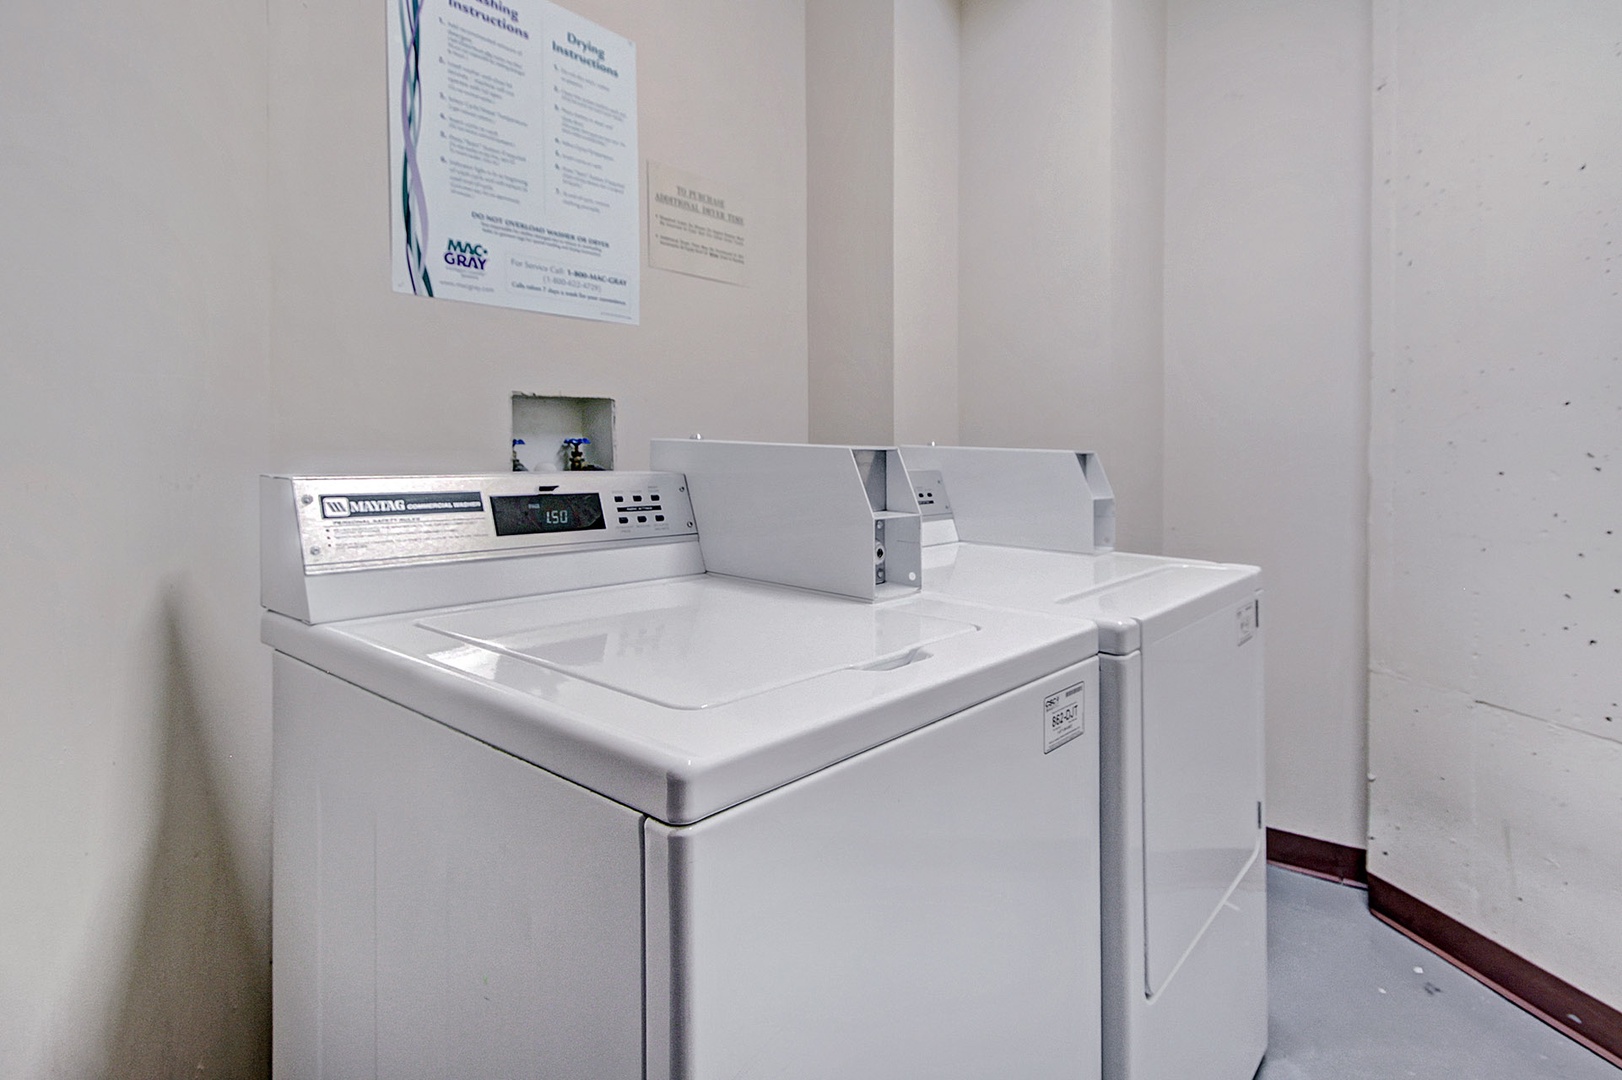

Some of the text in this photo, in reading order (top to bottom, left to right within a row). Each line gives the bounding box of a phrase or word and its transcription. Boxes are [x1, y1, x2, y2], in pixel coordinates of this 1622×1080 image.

[448, 0, 529, 40] Instructions
[552, 40, 619, 78] Instructions
[567, 31, 605, 61] Drying
[655, 192, 744, 226] ADDITIONAL DRYER TIME
[676, 185, 725, 208] TO PURCHASE
[471, 211, 609, 248] DO NOT OVERLOAD WASHER OR DRYER
[444, 252, 487, 270] GRAY
[511, 258, 522, 267] For
[524, 261, 548, 272] Service
[567, 269, 627, 286] 1-800-MAC-GRAY
[511, 281, 525, 289] Calls
[349, 499, 406, 513] MAYTAG
[407, 502, 453, 510] COMMERCIAL
